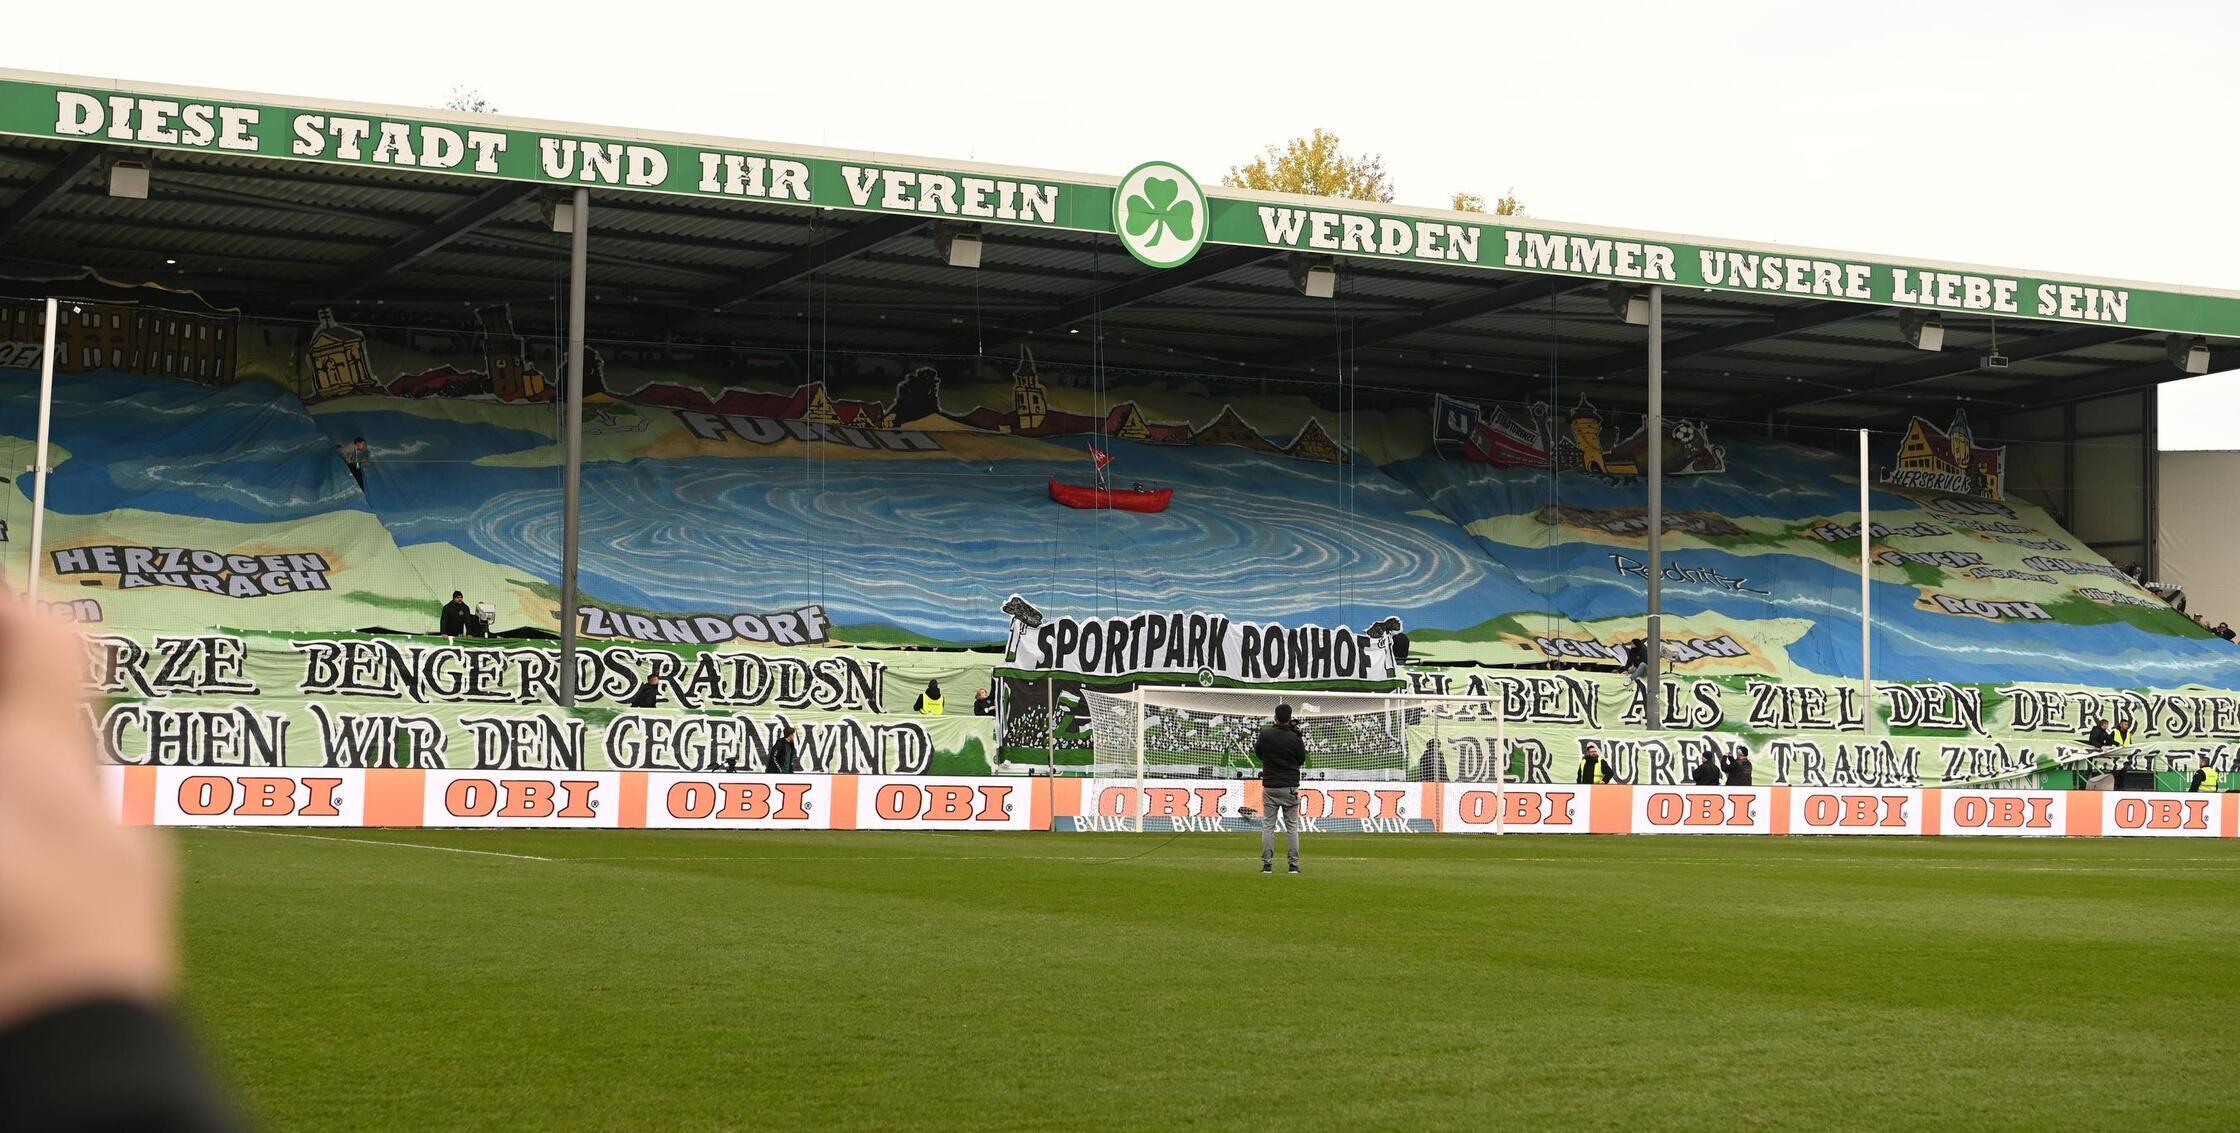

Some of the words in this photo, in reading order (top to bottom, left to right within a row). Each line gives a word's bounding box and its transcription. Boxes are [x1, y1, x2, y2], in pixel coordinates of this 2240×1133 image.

[54, 91, 260, 152] DIESE
[291, 113, 508, 175] STADT
[539, 137, 669, 187] UND
[699, 152, 811, 201] IHR
[841, 166, 1058, 224] VEREIN
[1257, 206, 1481, 263] WERDEN
[1504, 230, 1676, 282] IMMER
[1699, 250, 1872, 299] UNSERE
[1892, 268, 2018, 313] LIEBE
[2037, 283, 2129, 323] SEIN
[1893, 470, 1972, 493] HERSBRUCK
[52, 546, 331, 575] HERZOGEN
[120, 570, 331, 598] AURACH
[1933, 594, 2056, 620] ROTH
[578, 606, 830, 644] ZIRNDORF
[1036, 613, 1229, 672] SPORTPARK
[1241, 625, 1373, 678] RONHOF
[1406, 671, 1602, 729] HABEN
[1622, 678, 1724, 730] ALS
[1749, 681, 1864, 732] ZIEL
[1876, 684, 1993, 738] DEN
[1996, 689, 2240, 738] DERBYSIE
[309, 704, 448, 768] WIR
[460, 716, 586, 771] DEN
[605, 714, 934, 775] GEGENWIND
[1771, 741, 1923, 787] TRAUM
[1940, 743, 2038, 782] ZUM
